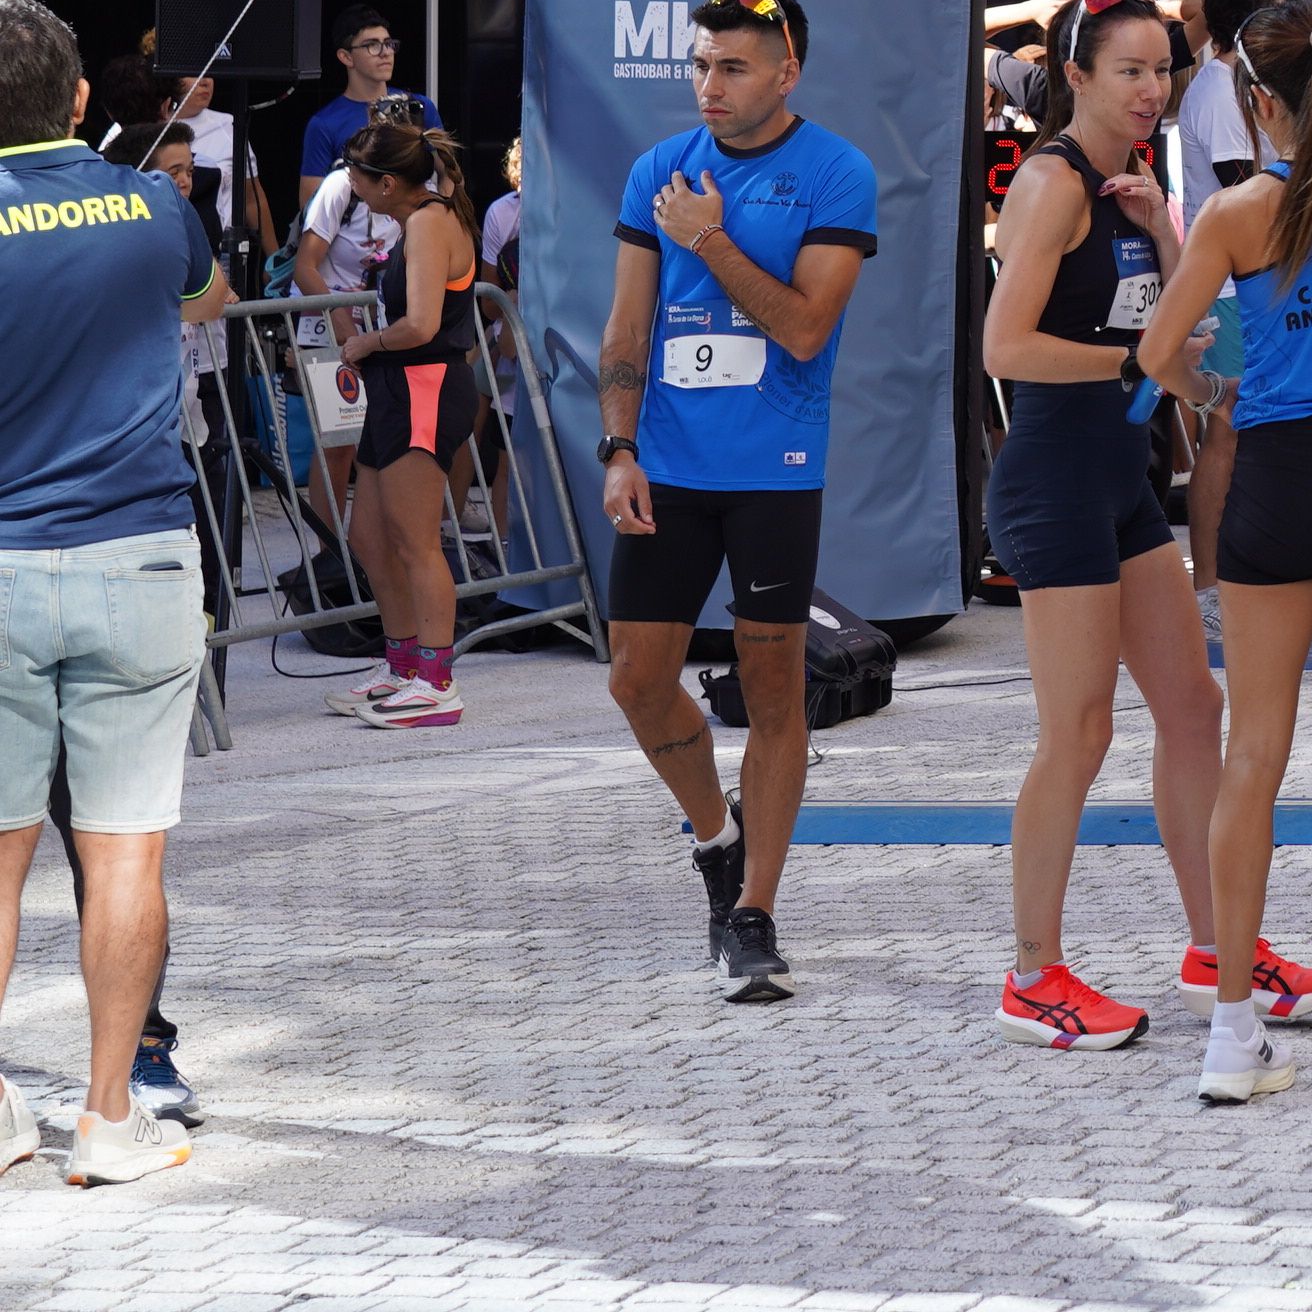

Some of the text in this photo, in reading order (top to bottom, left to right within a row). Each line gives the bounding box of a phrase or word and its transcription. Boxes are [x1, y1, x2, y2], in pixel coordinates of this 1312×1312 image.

[614, 63, 681, 79] GASTROBAR &
[696, 344, 713, 372] 9
